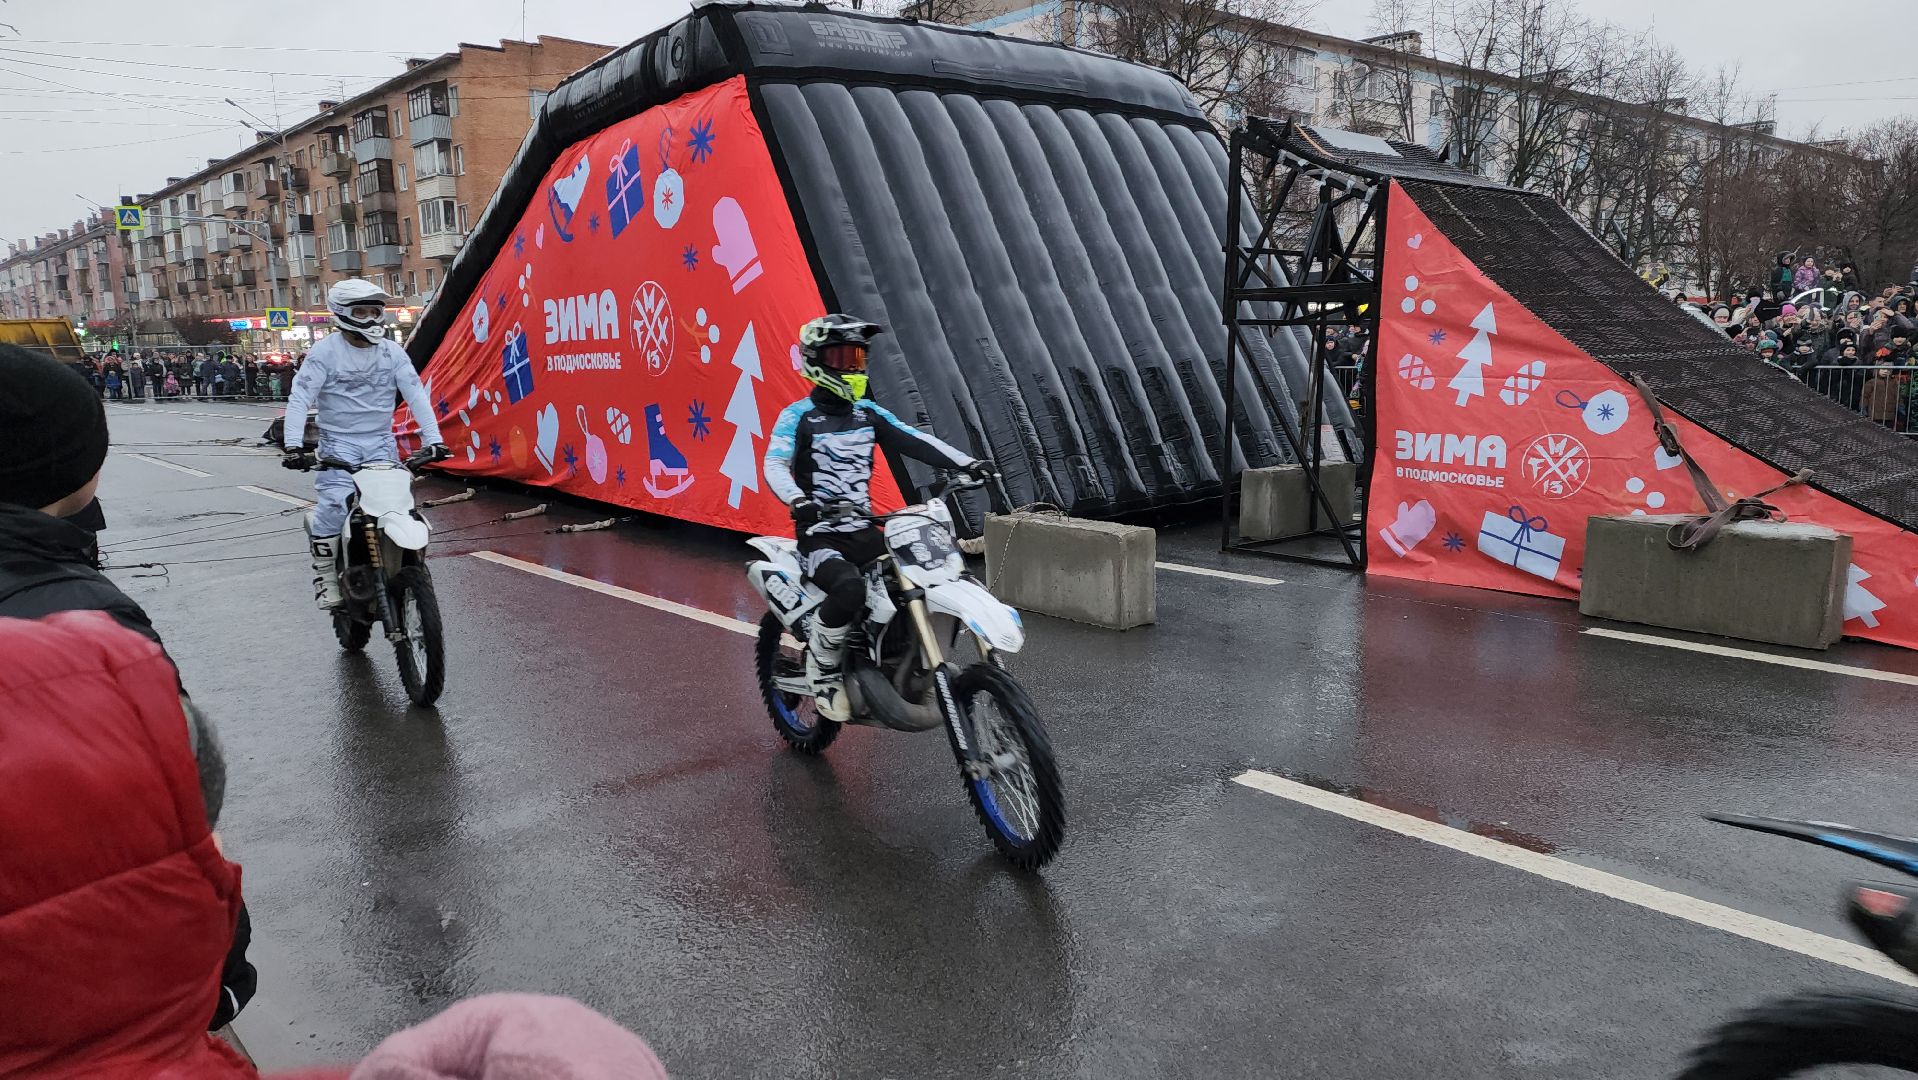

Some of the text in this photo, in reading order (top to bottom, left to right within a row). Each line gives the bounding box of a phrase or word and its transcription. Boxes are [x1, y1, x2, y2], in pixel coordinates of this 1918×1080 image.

[543, 288, 620, 345] ЗИМА
[546, 352, 622, 374] В ПОДМОСКОВЬЕ
[1395, 429, 1507, 468] ЗИМА
[1404, 467, 1505, 488] ПОДМОСКОВЬЕ
